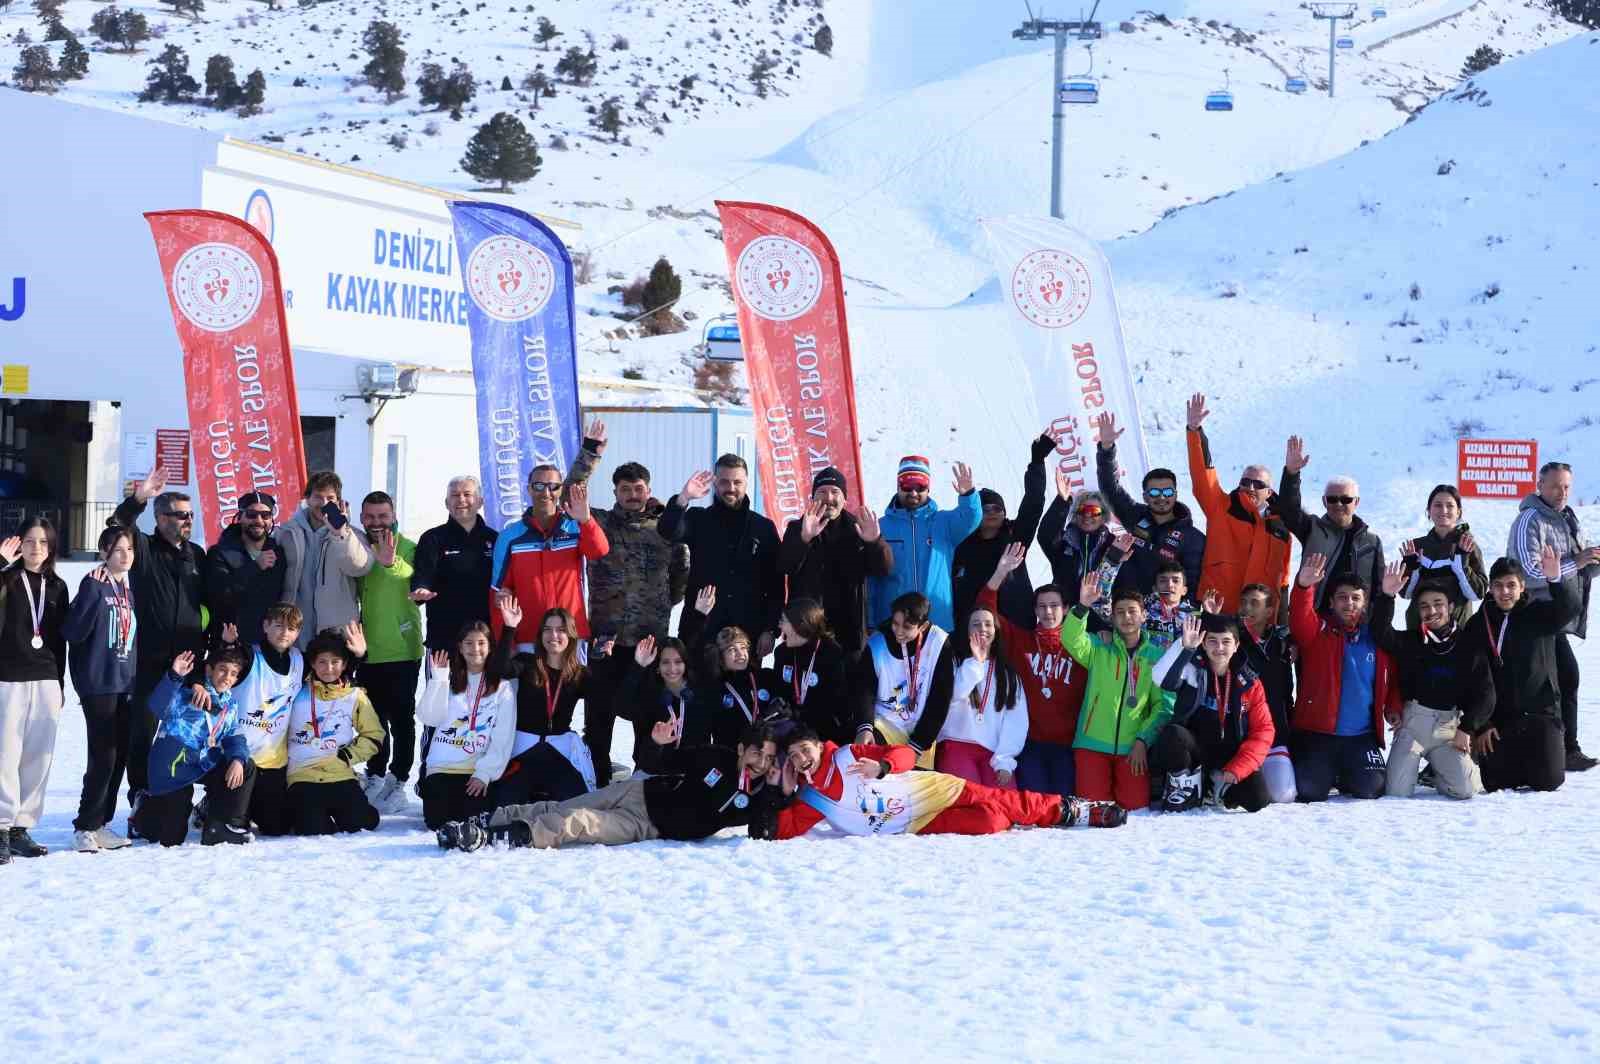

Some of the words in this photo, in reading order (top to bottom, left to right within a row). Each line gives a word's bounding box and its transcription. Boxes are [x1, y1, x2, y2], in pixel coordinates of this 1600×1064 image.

[374, 227, 452, 277] DENİZLİ
[327, 272, 397, 318] KAYAK
[1464, 443, 1500, 455] KIZAKLA
[1501, 444, 1531, 456] KAYMA
[1461, 469, 1497, 481] KIZAKLA
[1498, 470, 1533, 482] KAYMAK
[1476, 483, 1518, 496] YASAKTIR
